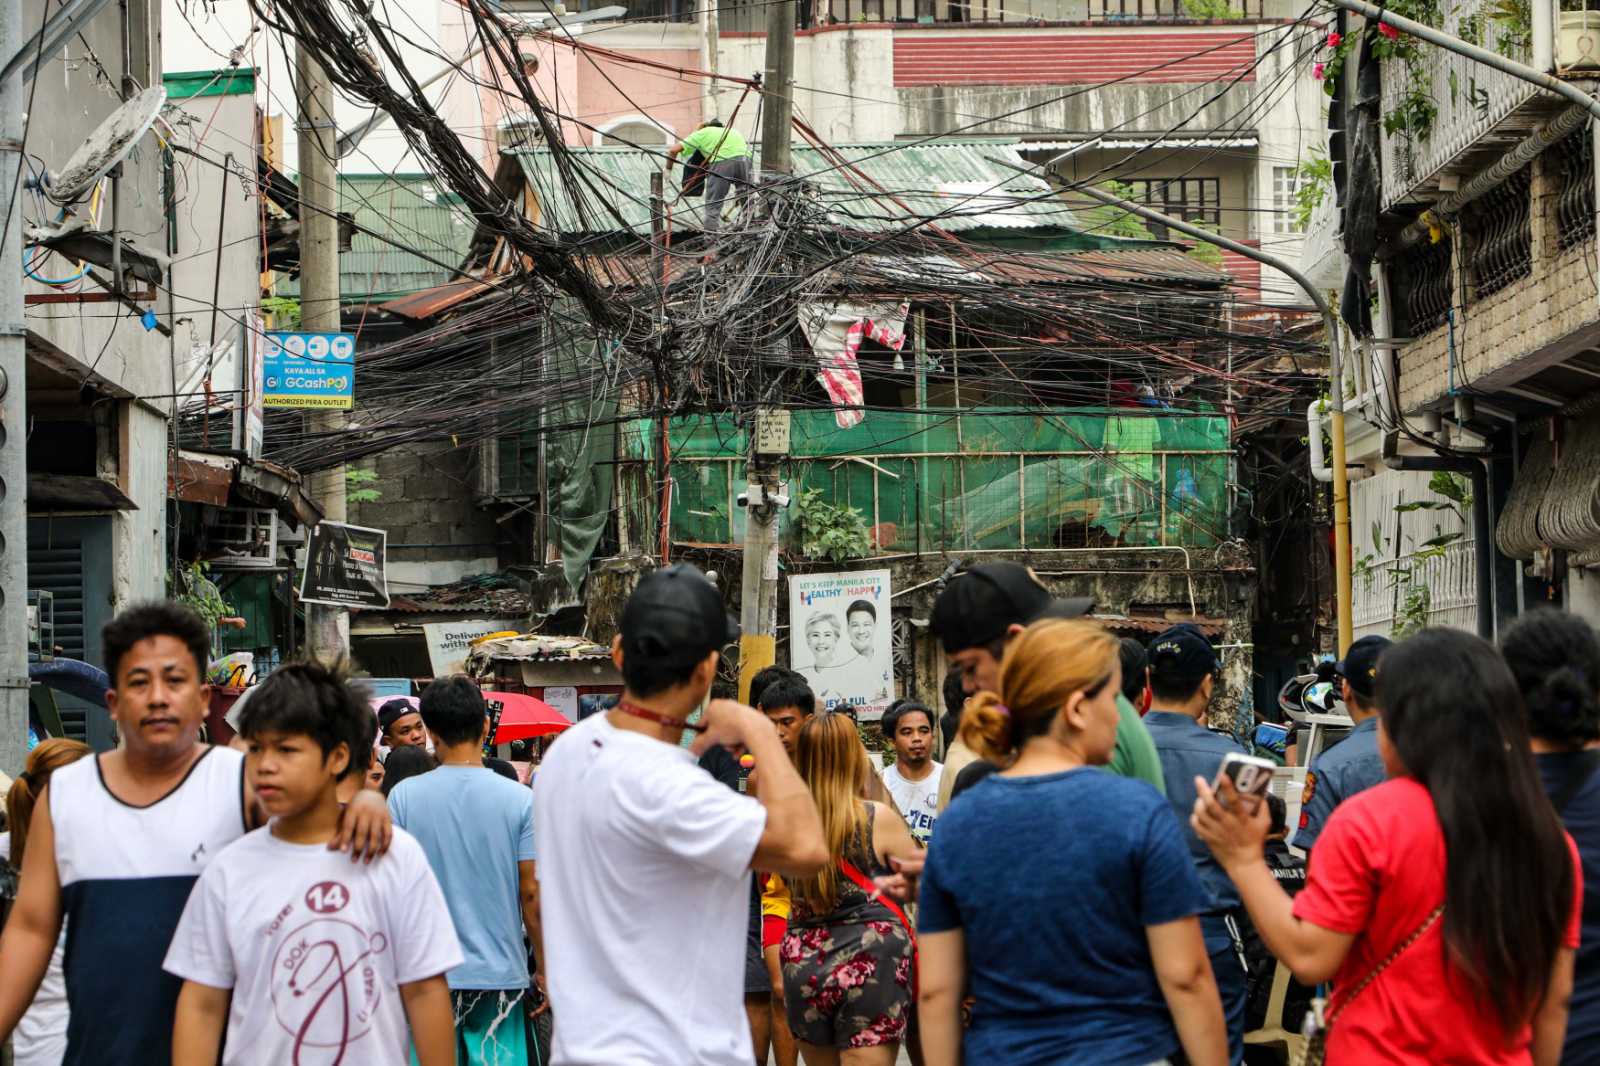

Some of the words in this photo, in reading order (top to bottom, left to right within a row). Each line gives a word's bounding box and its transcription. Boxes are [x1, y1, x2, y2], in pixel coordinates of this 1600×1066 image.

[284, 367, 303, 375] KAYA
[304, 367, 315, 375] ALL
[818, 580, 835, 588] KEEP
[836, 578, 865, 586] MANILA
[800, 588, 842, 605] HEALTHY
[440, 639, 466, 649] with
[307, 884, 345, 912] 14
[283, 938, 311, 970] DOK
